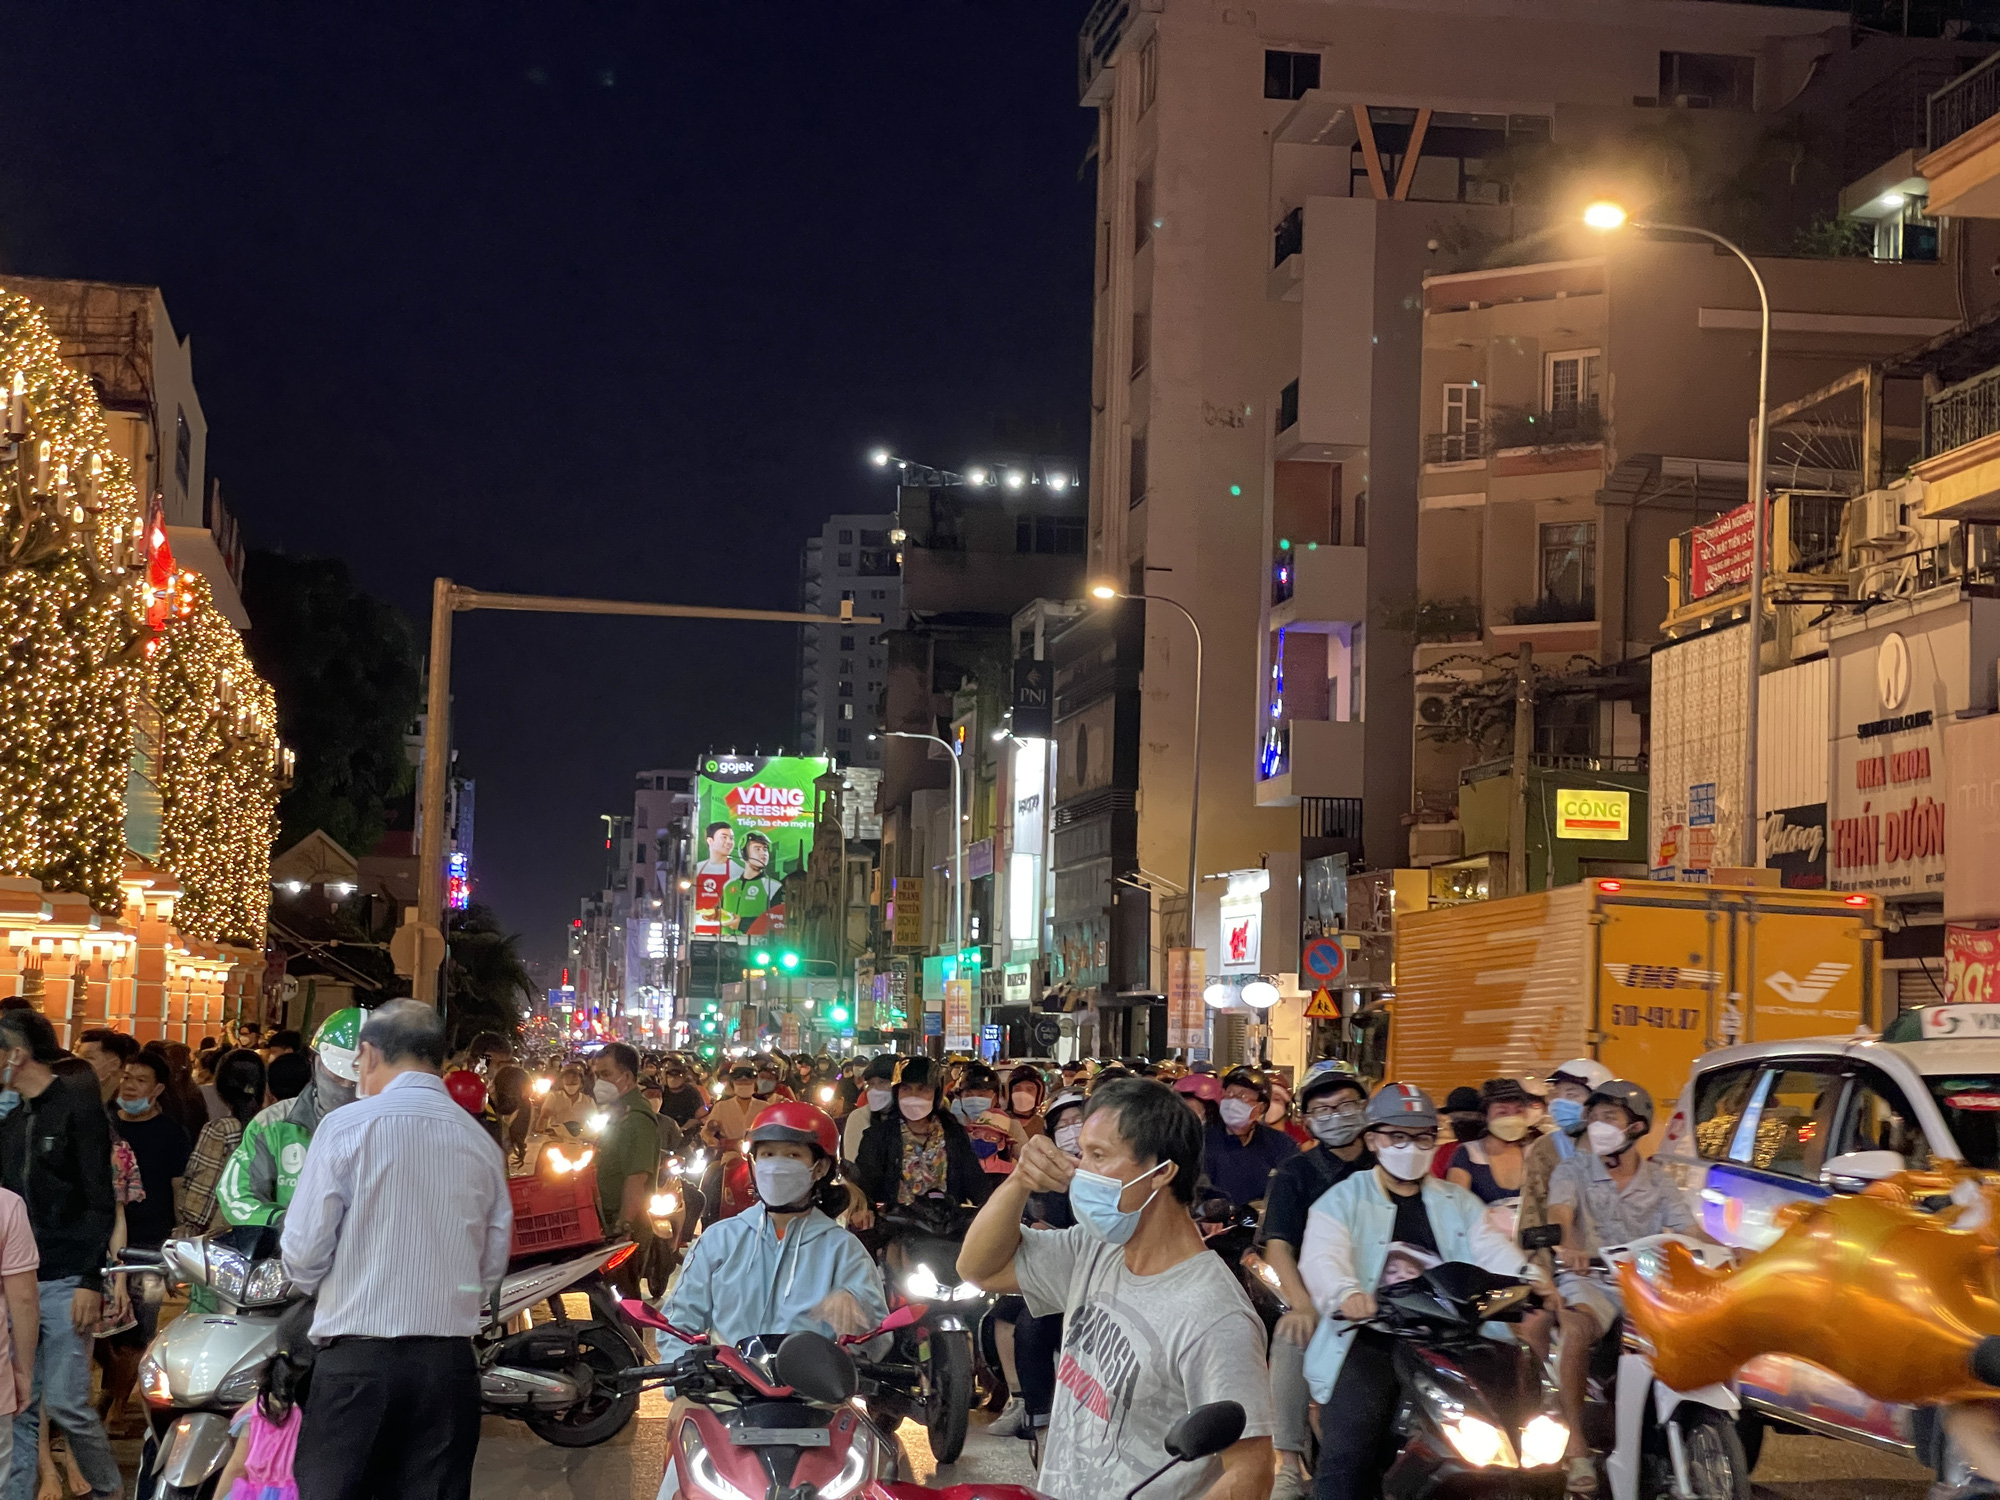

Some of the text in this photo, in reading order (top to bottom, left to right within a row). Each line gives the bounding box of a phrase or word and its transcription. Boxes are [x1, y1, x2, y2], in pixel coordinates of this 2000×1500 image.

[1020, 687, 1046, 705] PNJ
[719, 762, 754, 774] gojek
[1856, 747, 1931, 789] NHA KHOA
[737, 783, 805, 806] VÙNG
[1564, 799, 1622, 819] CỘNG
[1831, 796, 1945, 868] THÁI DƯƠN
[277, 1174, 300, 1187] Gra
